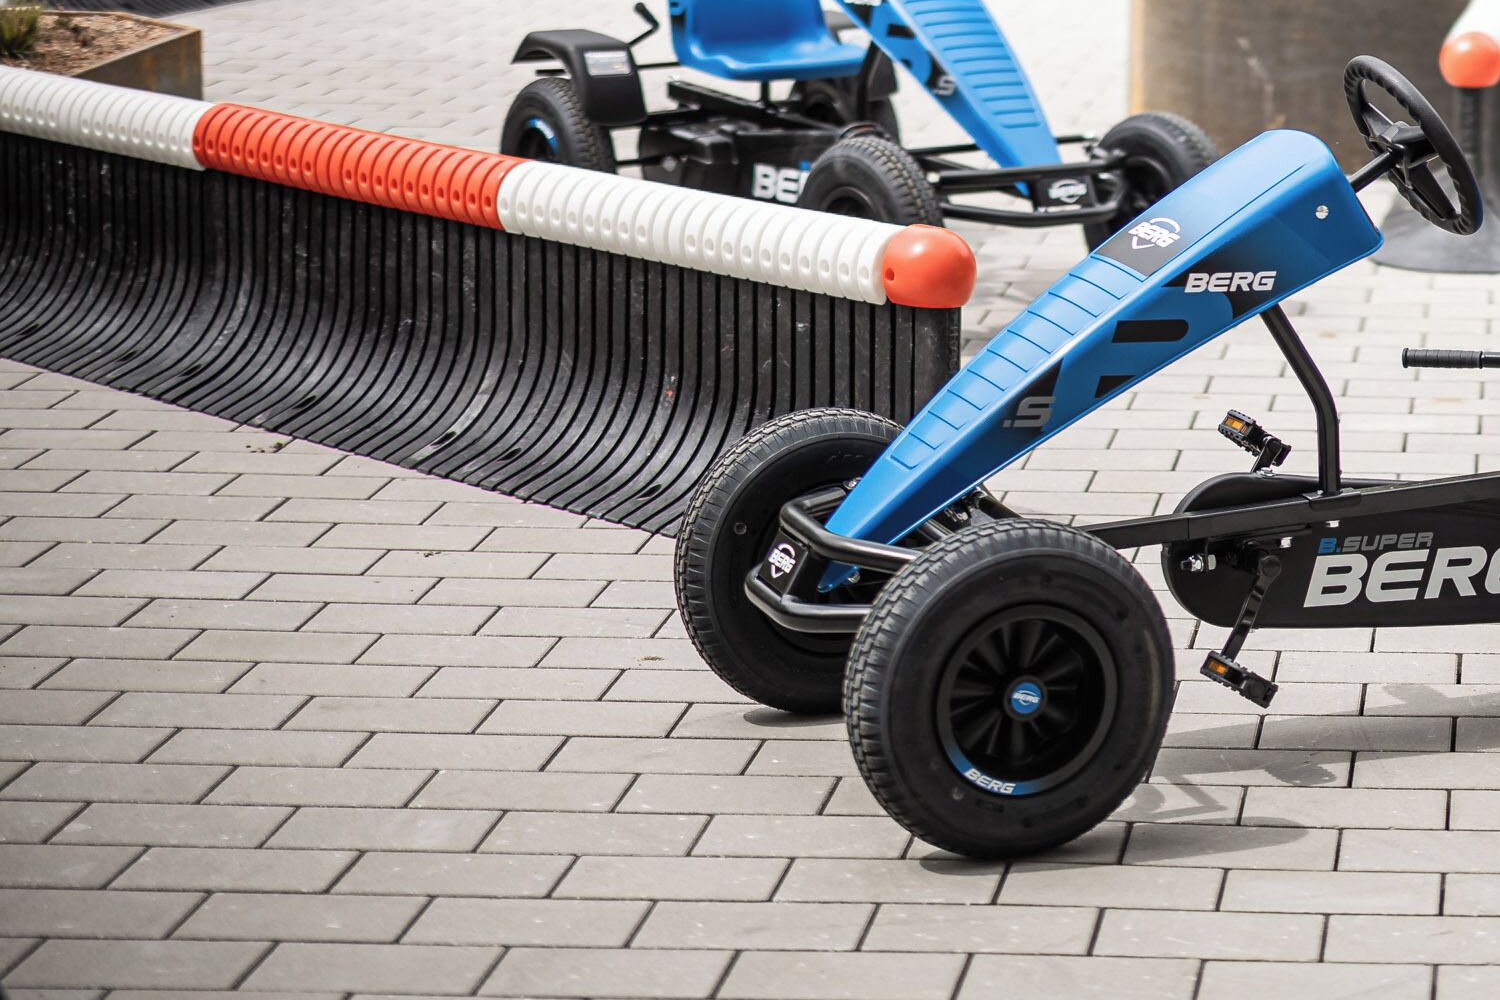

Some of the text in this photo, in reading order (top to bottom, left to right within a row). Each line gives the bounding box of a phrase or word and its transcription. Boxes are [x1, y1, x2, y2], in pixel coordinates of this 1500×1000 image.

[1127, 221, 1181, 249] BERG
[1184, 271, 1277, 293] BERG
[768, 548, 796, 574] BERG
[963, 767, 1016, 795] BERG
